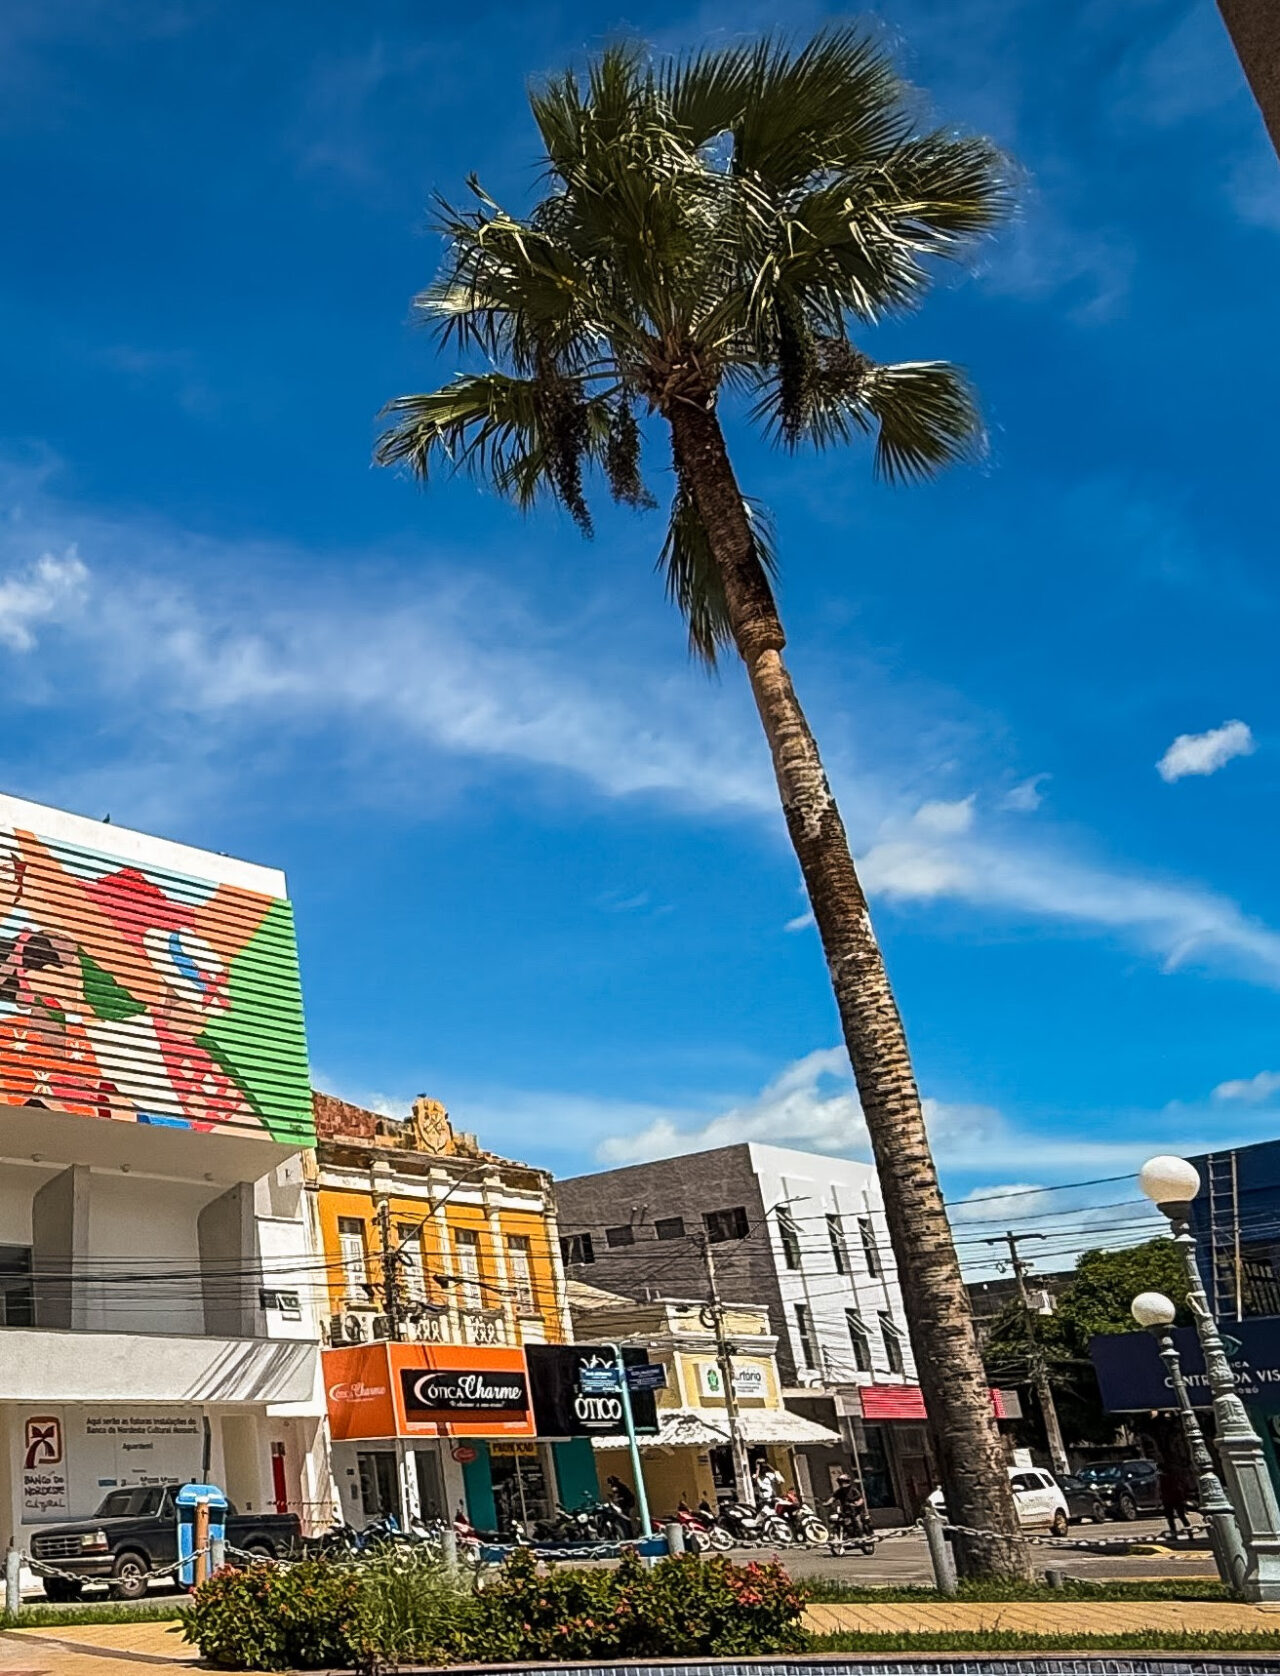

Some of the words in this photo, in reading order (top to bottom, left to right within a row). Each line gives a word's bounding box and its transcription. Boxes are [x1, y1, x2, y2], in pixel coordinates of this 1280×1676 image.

[428, 1384, 464, 1399] ÓTICA
[458, 1375, 522, 1400] Charme
[1164, 1375, 1211, 1389] CNTR
[574, 1393, 622, 1420] ÓTICO
[87, 1417, 101, 1426] Aqui
[130, 1417, 152, 1425] futuras
[153, 1417, 186, 1426] instalações
[147, 1426, 171, 1434] Cultural
[24, 1475, 51, 1485] BANCO
